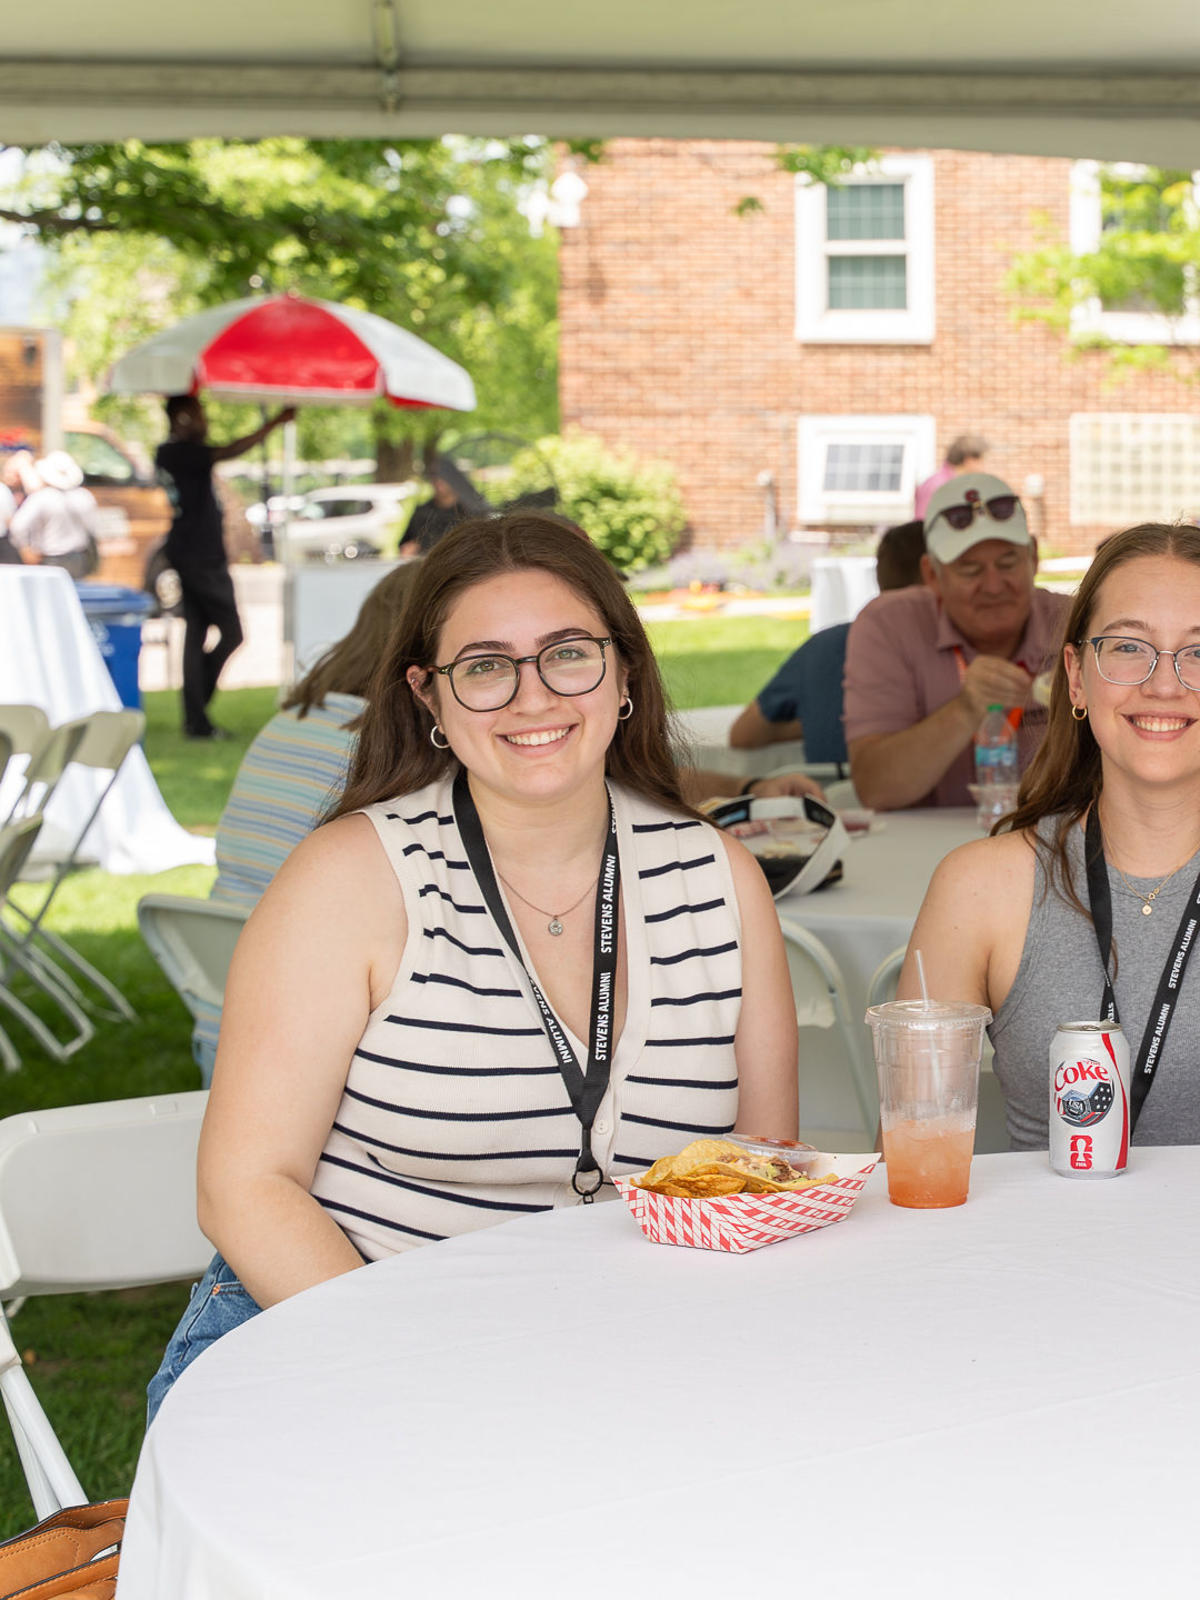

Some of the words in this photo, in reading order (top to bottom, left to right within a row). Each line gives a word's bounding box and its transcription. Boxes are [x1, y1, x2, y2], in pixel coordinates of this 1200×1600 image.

[602, 854, 617, 902] ALUMNI
[600, 903, 613, 953] STEVENS
[1168, 951, 1185, 989] STEVENS
[1180, 919, 1197, 951] ALUMNI
[598, 971, 612, 1013] ALUMNI
[546, 1017, 573, 1064] ALUMNI
[595, 1014, 609, 1061] STEVENS
[1144, 1036, 1161, 1075] STEVENS
[1155, 1003, 1171, 1037] ALUMNI
[1054, 1062, 1109, 1092] Coke
